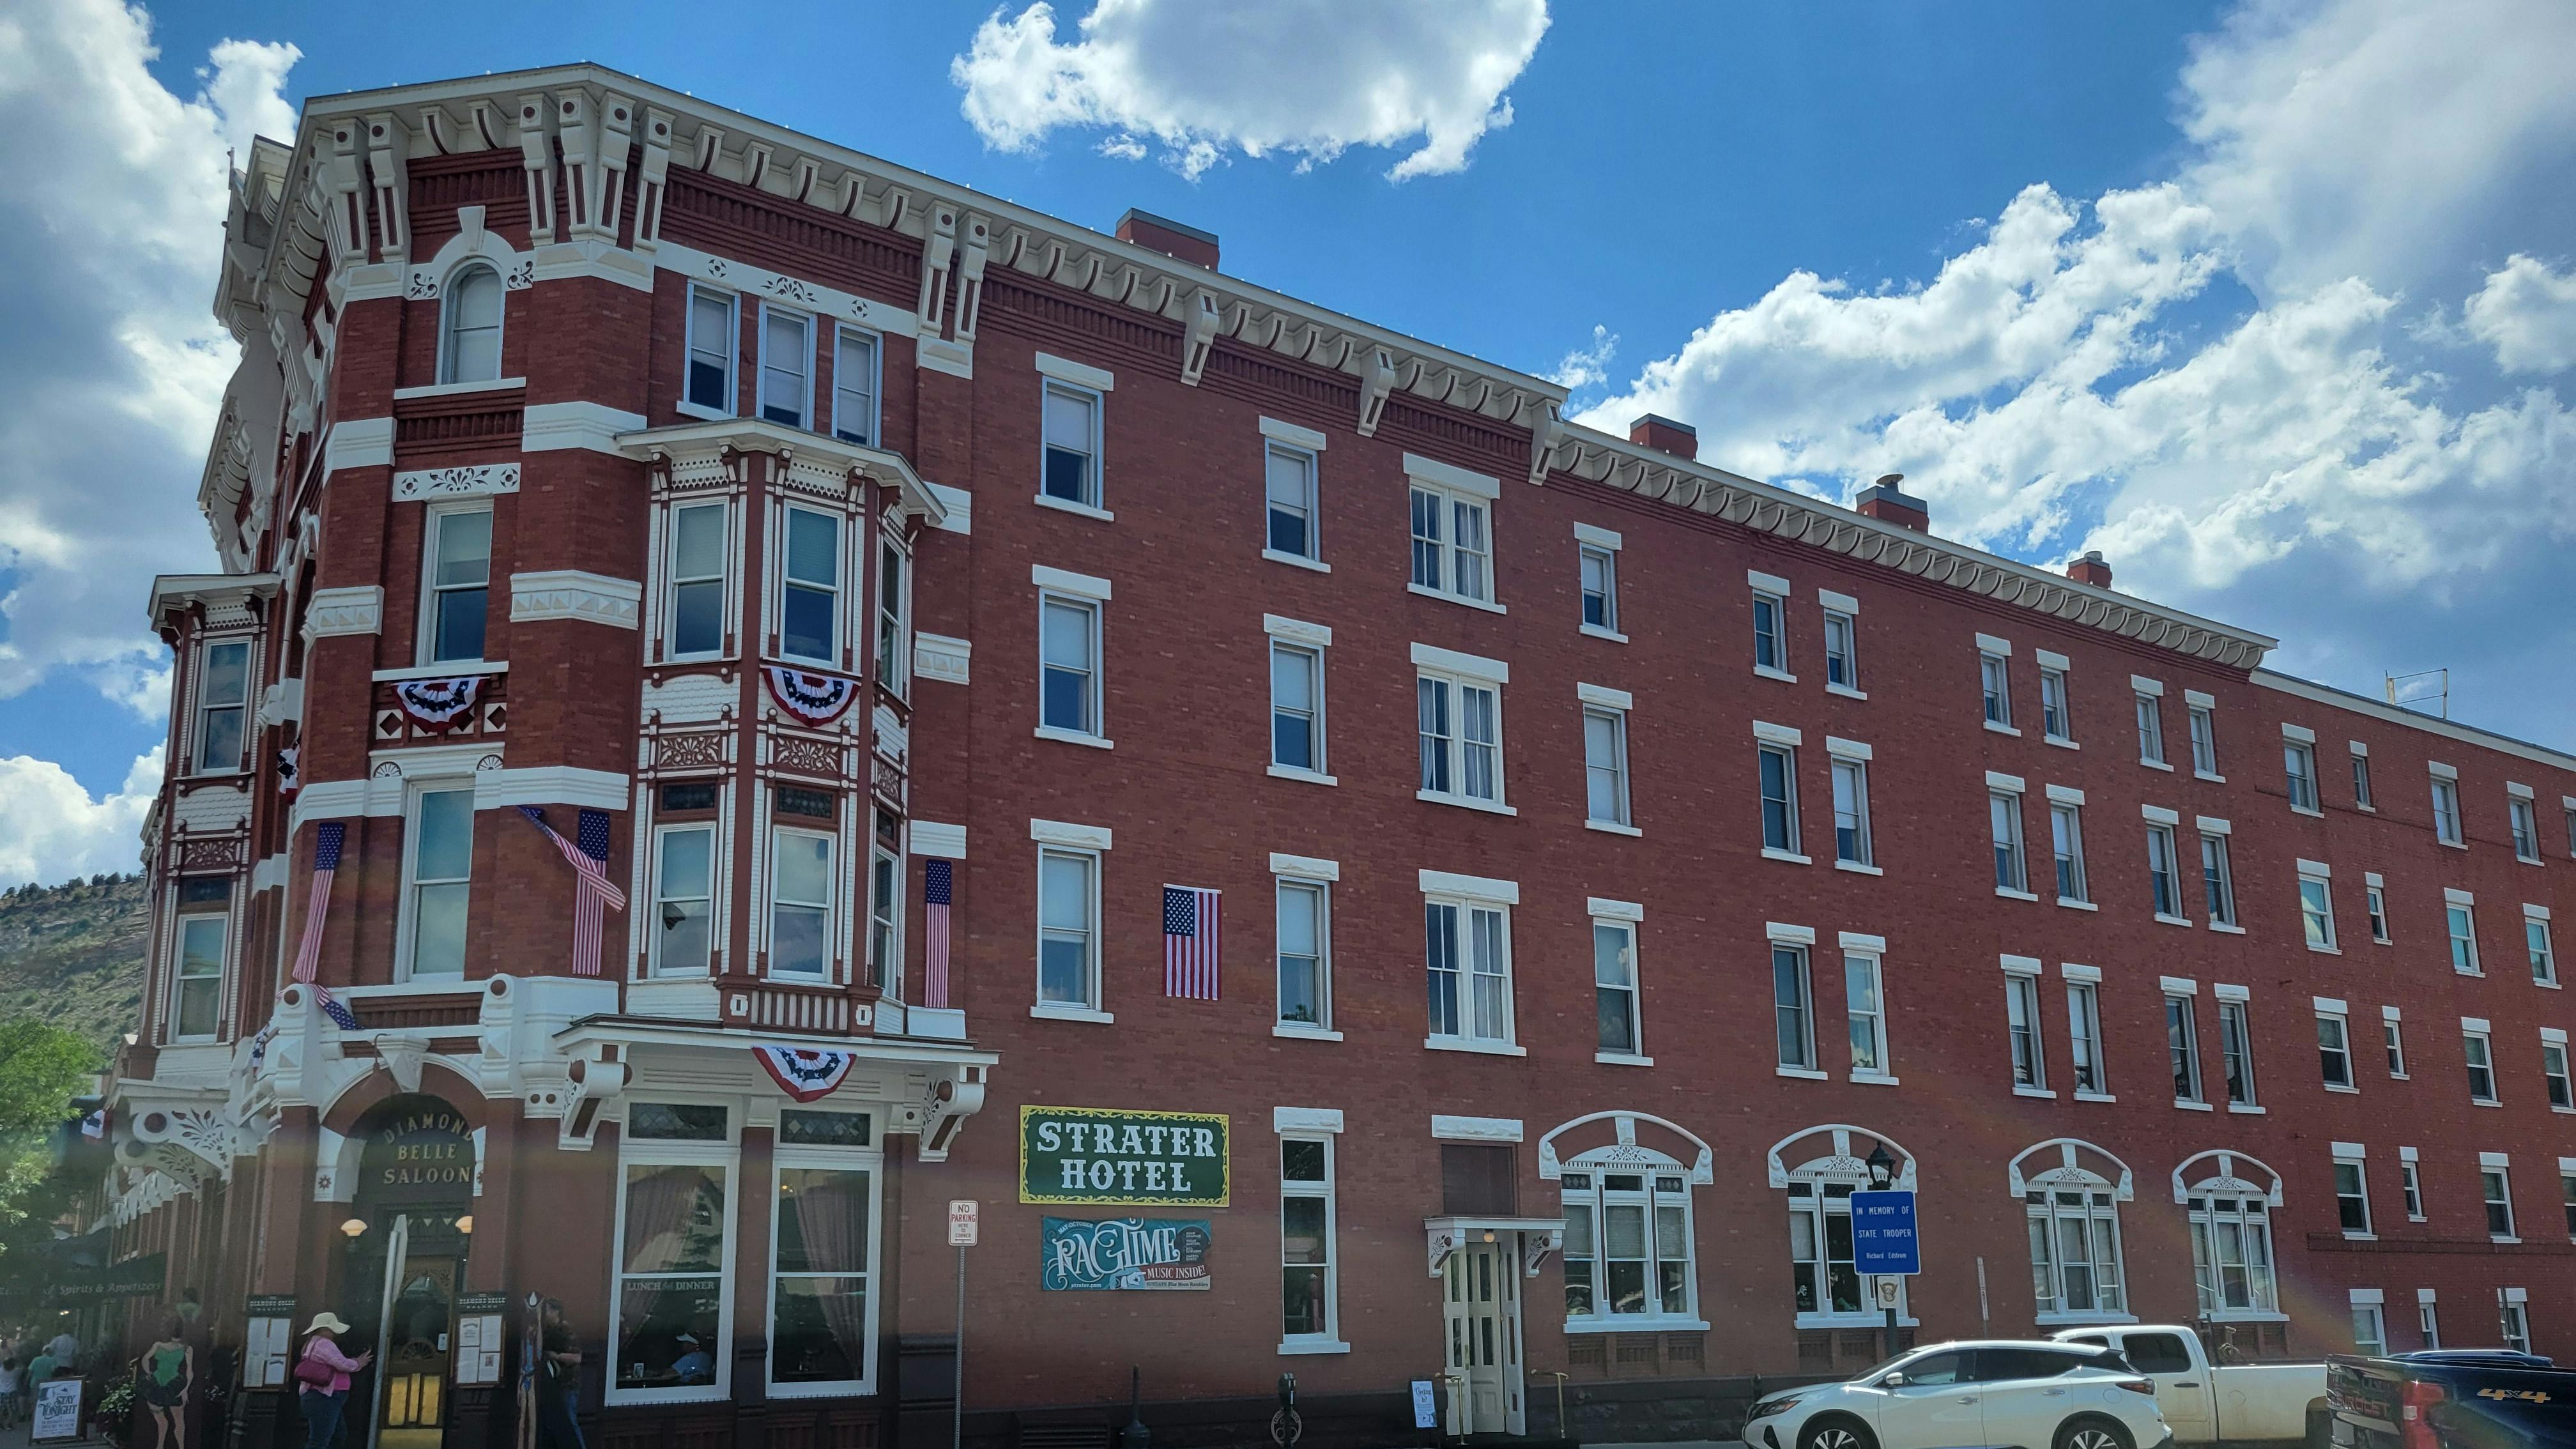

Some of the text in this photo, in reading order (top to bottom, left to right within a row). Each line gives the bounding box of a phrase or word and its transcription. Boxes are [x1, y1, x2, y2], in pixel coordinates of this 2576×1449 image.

[383, 1113, 475, 1145] DIAMOND
[1037, 1121, 1216, 1158] STRATER
[397, 1143, 457, 1160] BELLE
[384, 1167, 471, 1184] SALOON
[1060, 1158, 1192, 1192] HOTEL
[958, 1204, 970, 1213] NO
[1856, 1206, 1910, 1215] IN MEMORY OF
[951, 1214, 976, 1223] PARKING
[1858, 1229, 1912, 1238] STATE TROOPER
[1046, 1216, 1181, 1290] RAGTIME
[1147, 1264, 1207, 1279] MUSIC INSIDE!
[60, 1285, 94, 1296] Spirits
[627, 1282, 661, 1291] LUNCH
[675, 1282, 715, 1291] DINNER
[54, 1395, 76, 1406] STAY
[38, 1402, 78, 1420] TONIGHT
